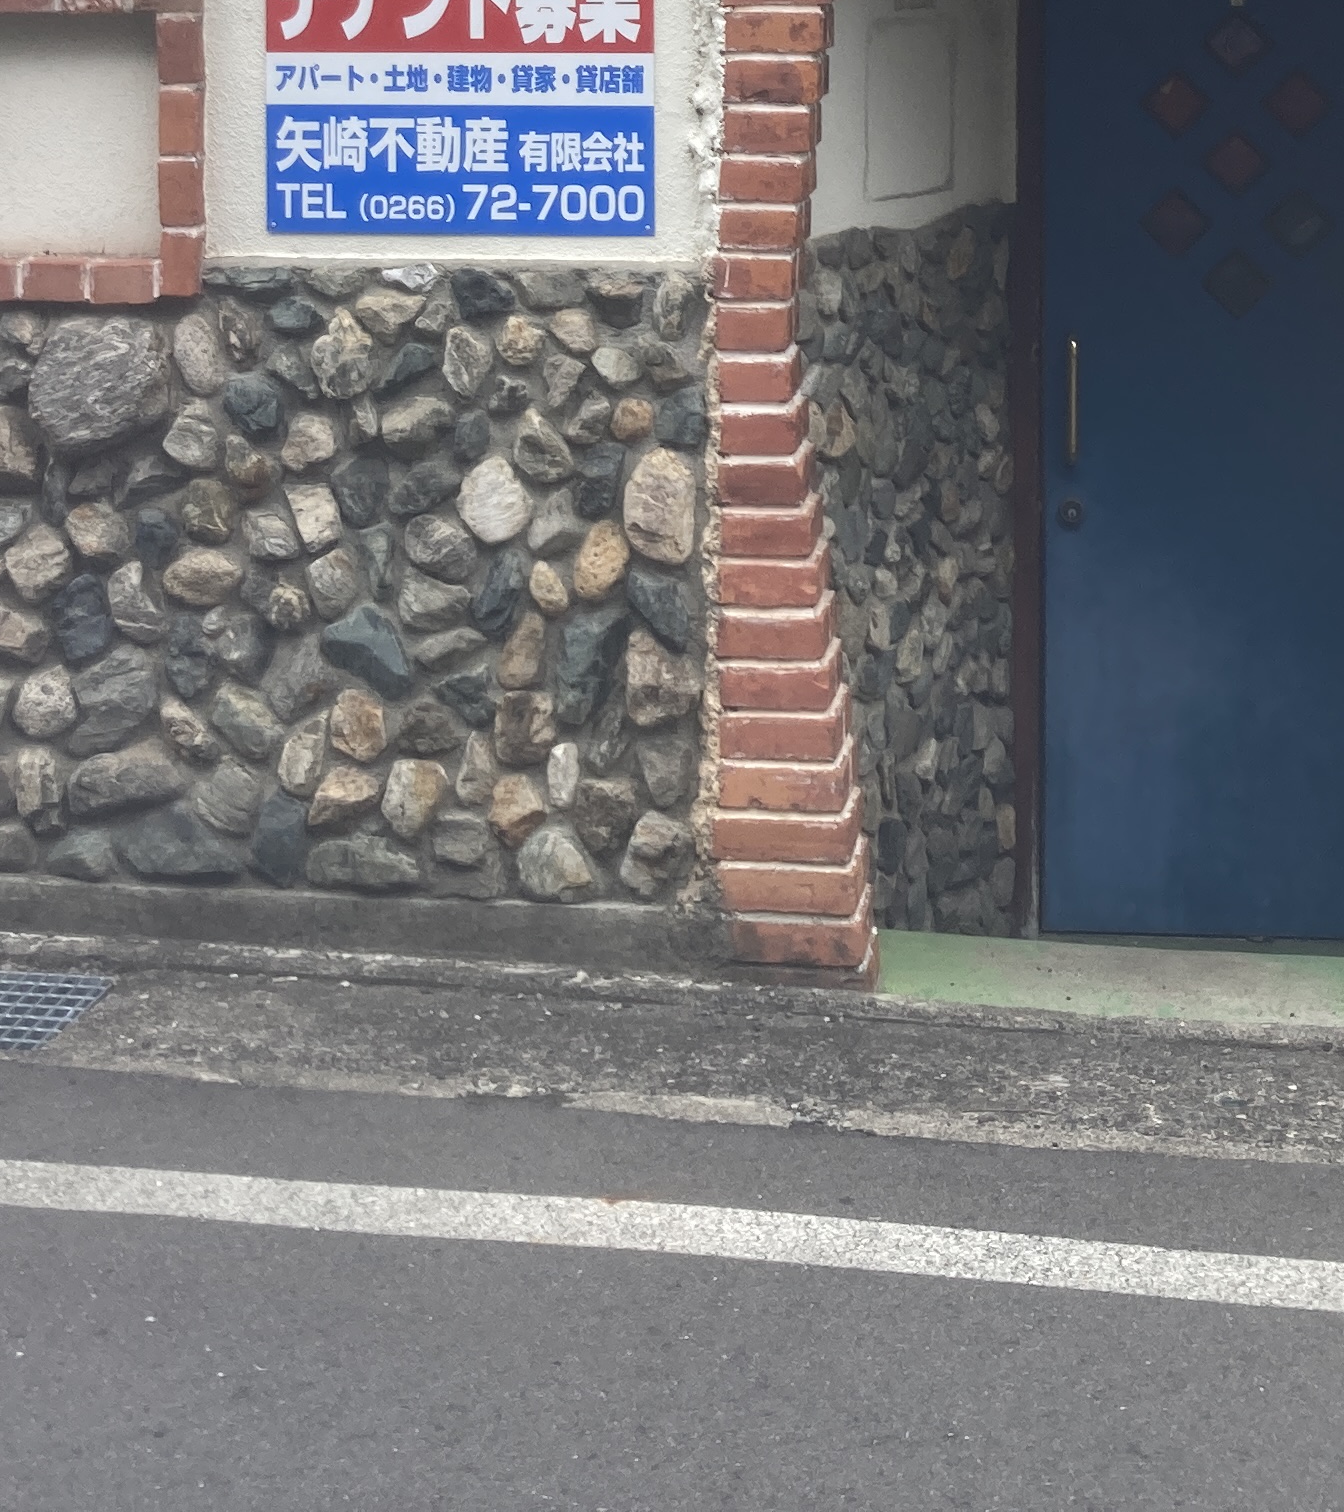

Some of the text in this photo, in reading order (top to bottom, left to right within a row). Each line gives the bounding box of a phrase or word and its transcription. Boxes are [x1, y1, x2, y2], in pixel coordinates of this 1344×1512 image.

[274, 64, 645, 94] アパート・土地・建物・貸家・貸店舗
[276, 116, 645, 173] 矢崎不動産 有限会社
[276, 183, 645, 223] TEL (0266) 72-7000
